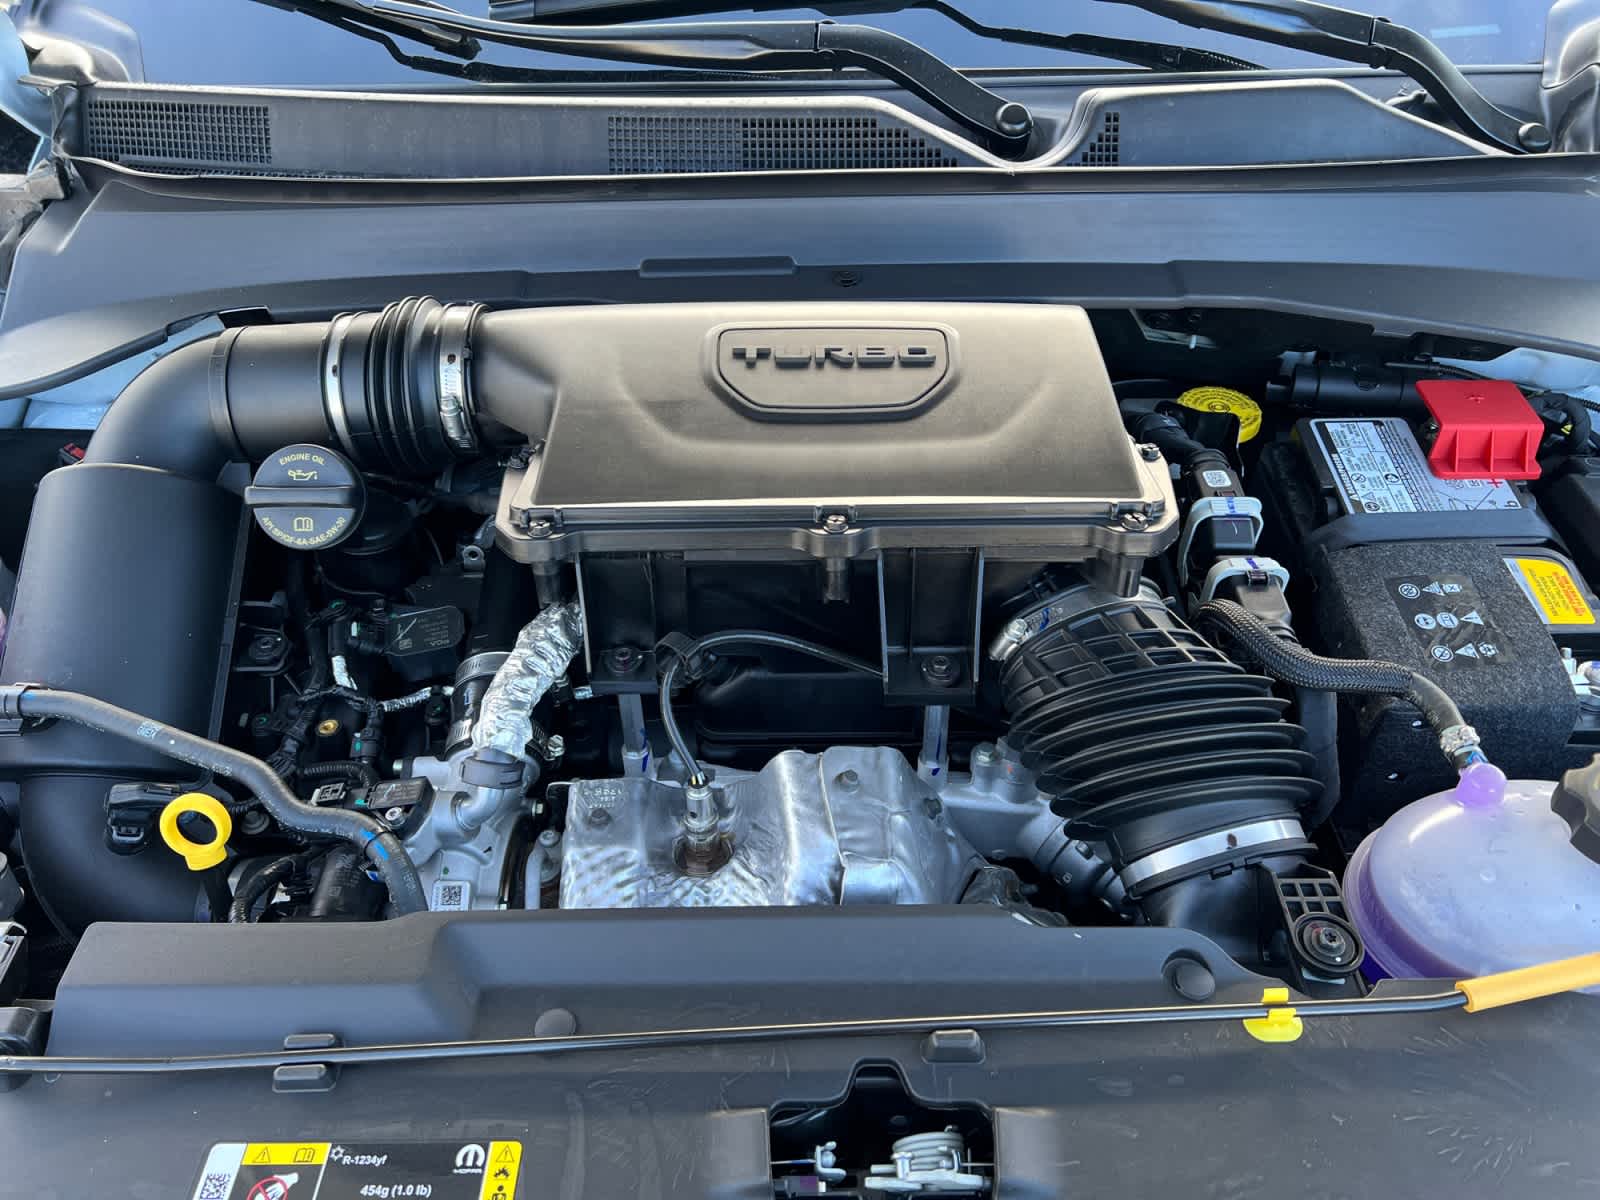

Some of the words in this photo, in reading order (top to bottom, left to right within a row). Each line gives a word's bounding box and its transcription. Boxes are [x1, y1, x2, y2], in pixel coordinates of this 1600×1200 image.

[732, 346, 937, 369] TURBO
[279, 453, 310, 466] ENGINE
[312, 454, 325, 465] OIL
[342, 1155, 388, 1167] R-1234yf
[360, 1184, 389, 1199] 454g
[391, 1184, 414, 1198] (1.0
[416, 1184, 432, 1198] lb)
